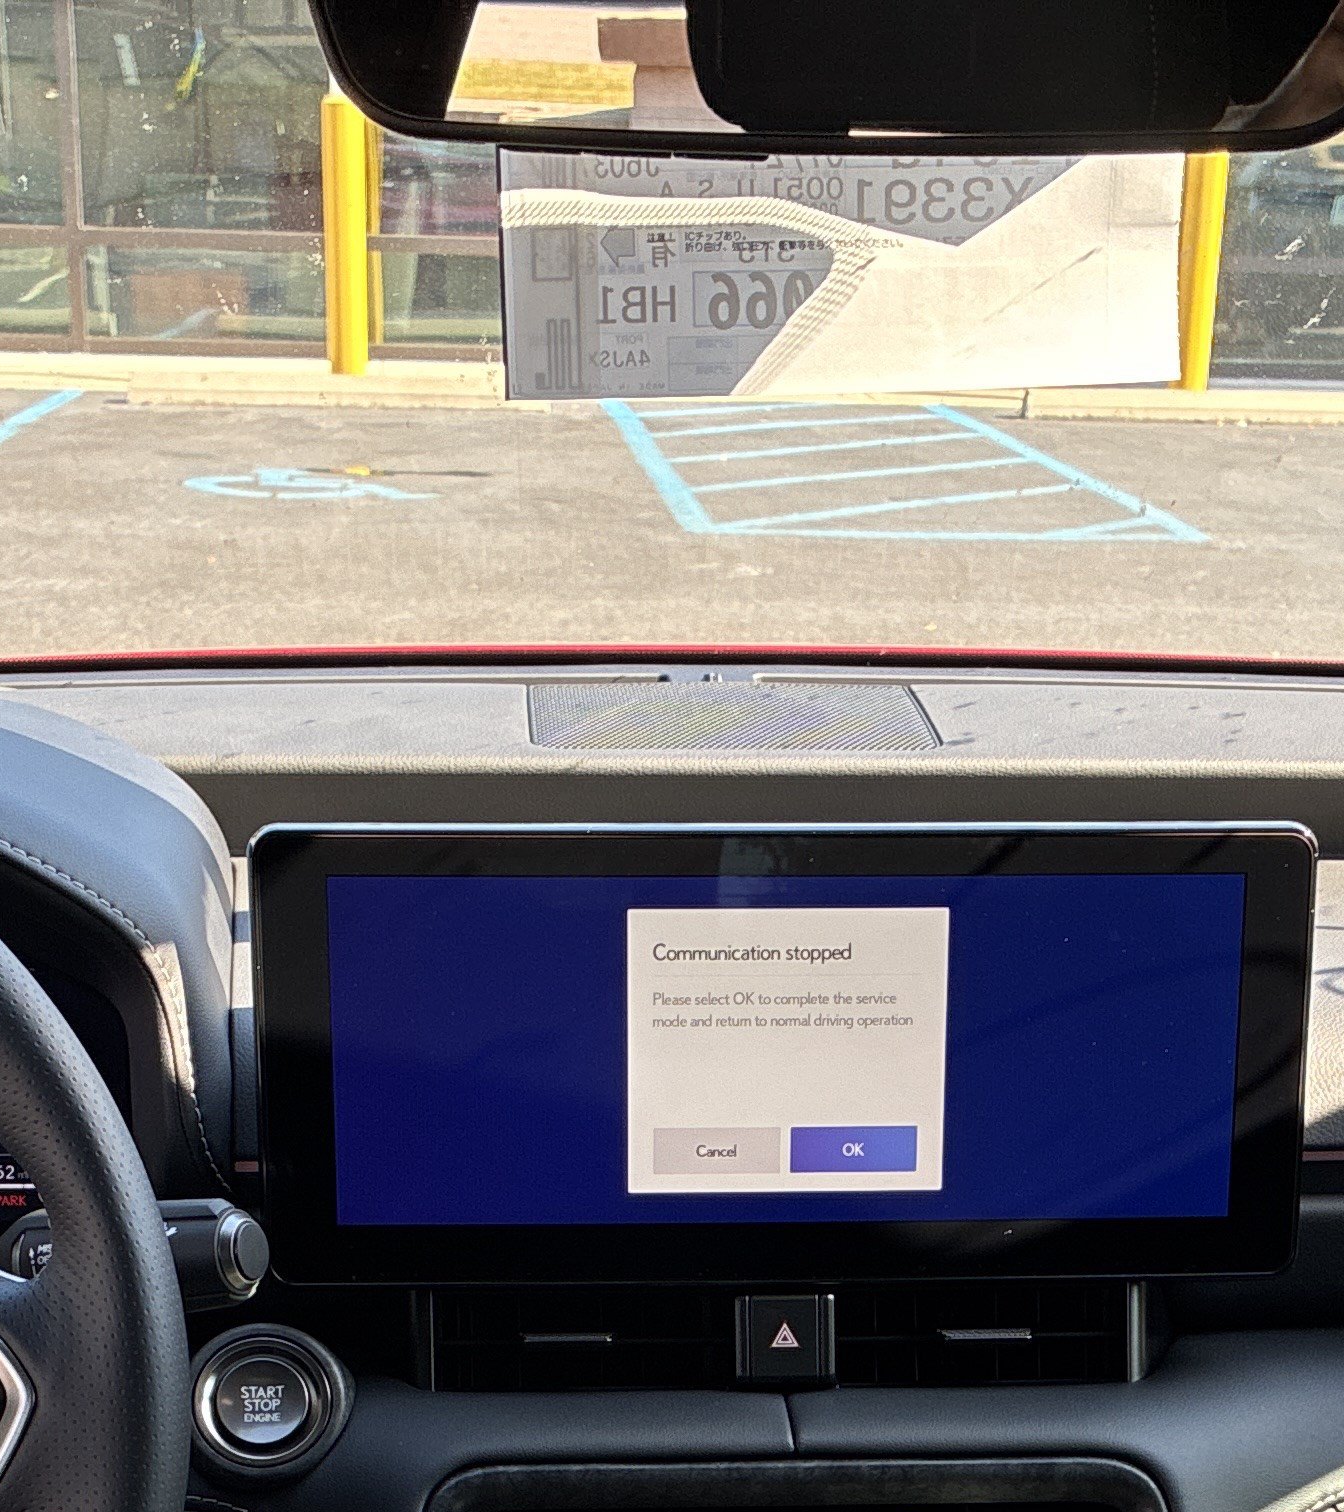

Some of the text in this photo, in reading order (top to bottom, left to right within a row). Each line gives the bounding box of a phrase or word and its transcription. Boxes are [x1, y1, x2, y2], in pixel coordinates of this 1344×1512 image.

[652, 942, 852, 965] Communication stopped
[652, 992, 898, 1009] Please select OK to complete the service
[652, 1013, 914, 1030] mode and return to normal driving operation
[695, 1142, 865, 1158] Cancel OK
[240, 1384, 286, 1399] START
[243, 1398, 281, 1412] STOP
[243, 1412, 282, 1423] ENGINE
